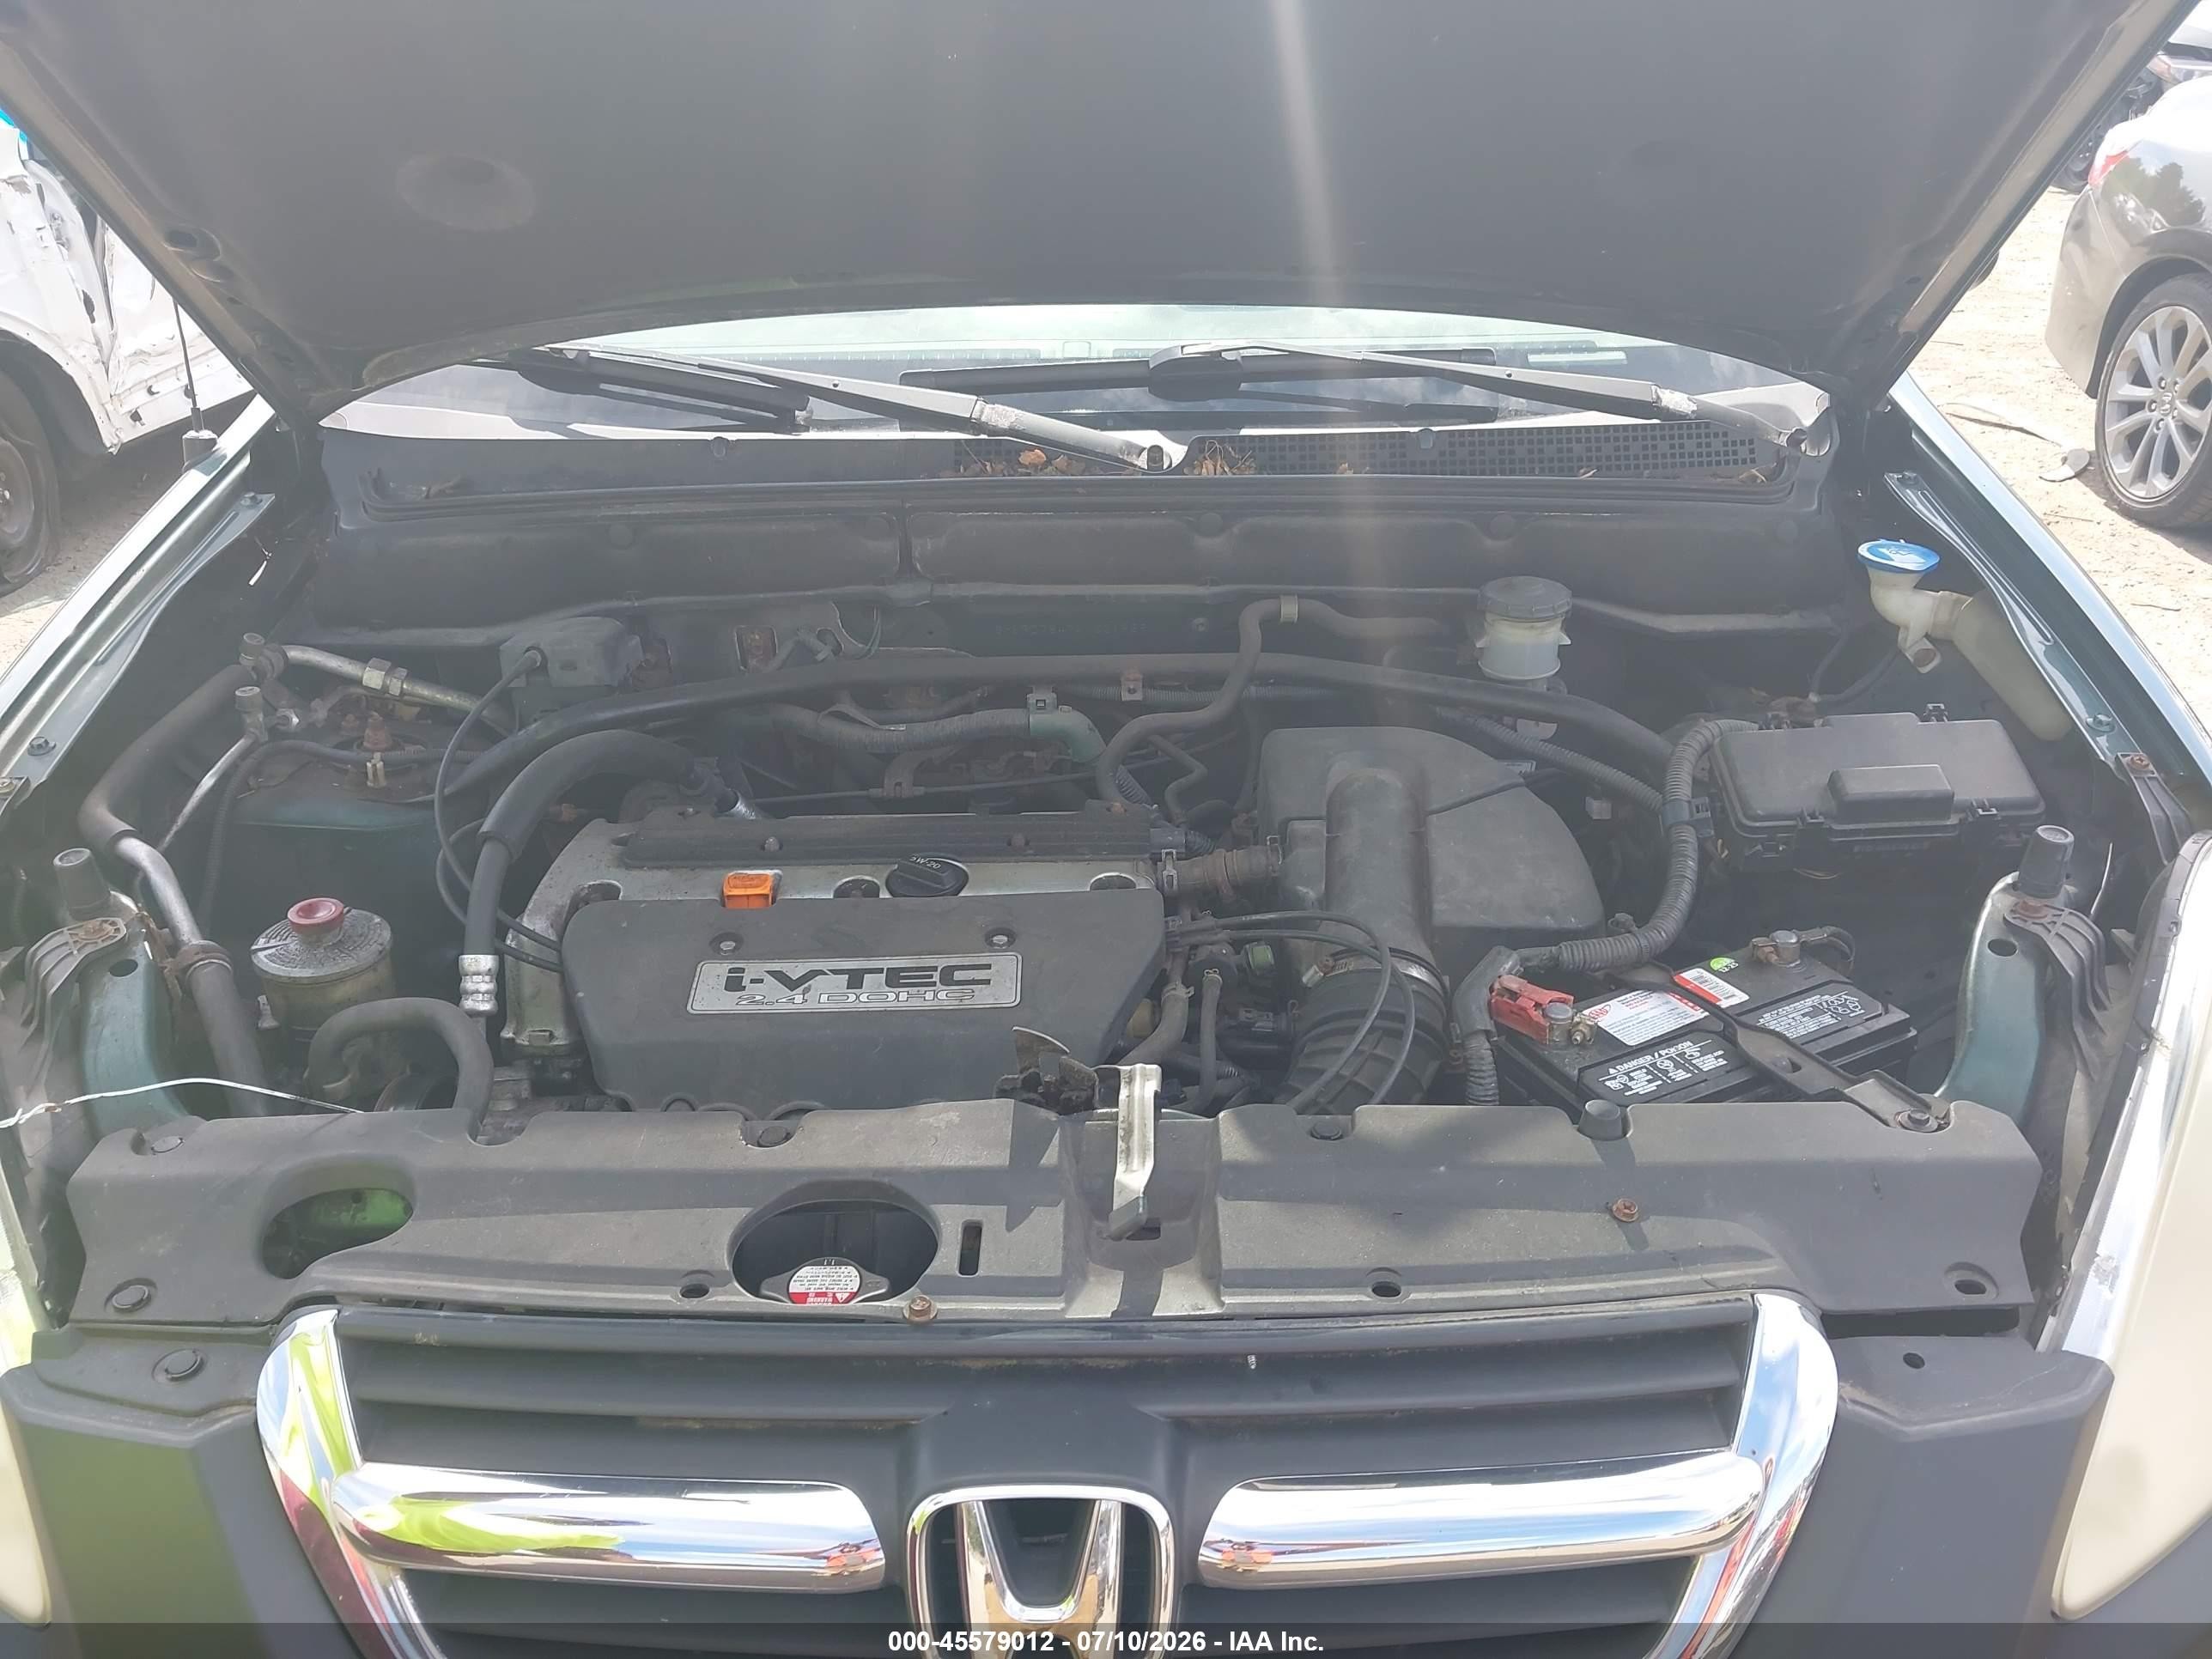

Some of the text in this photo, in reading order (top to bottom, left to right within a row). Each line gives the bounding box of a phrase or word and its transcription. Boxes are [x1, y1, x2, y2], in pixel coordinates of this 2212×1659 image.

[724, 963, 992, 993] i-VTEC
[735, 988, 975, 1006] 2.4 DOHC
[1616, 1054, 1655, 1072] DANGER
[1658, 1041, 1694, 1057] POISON
